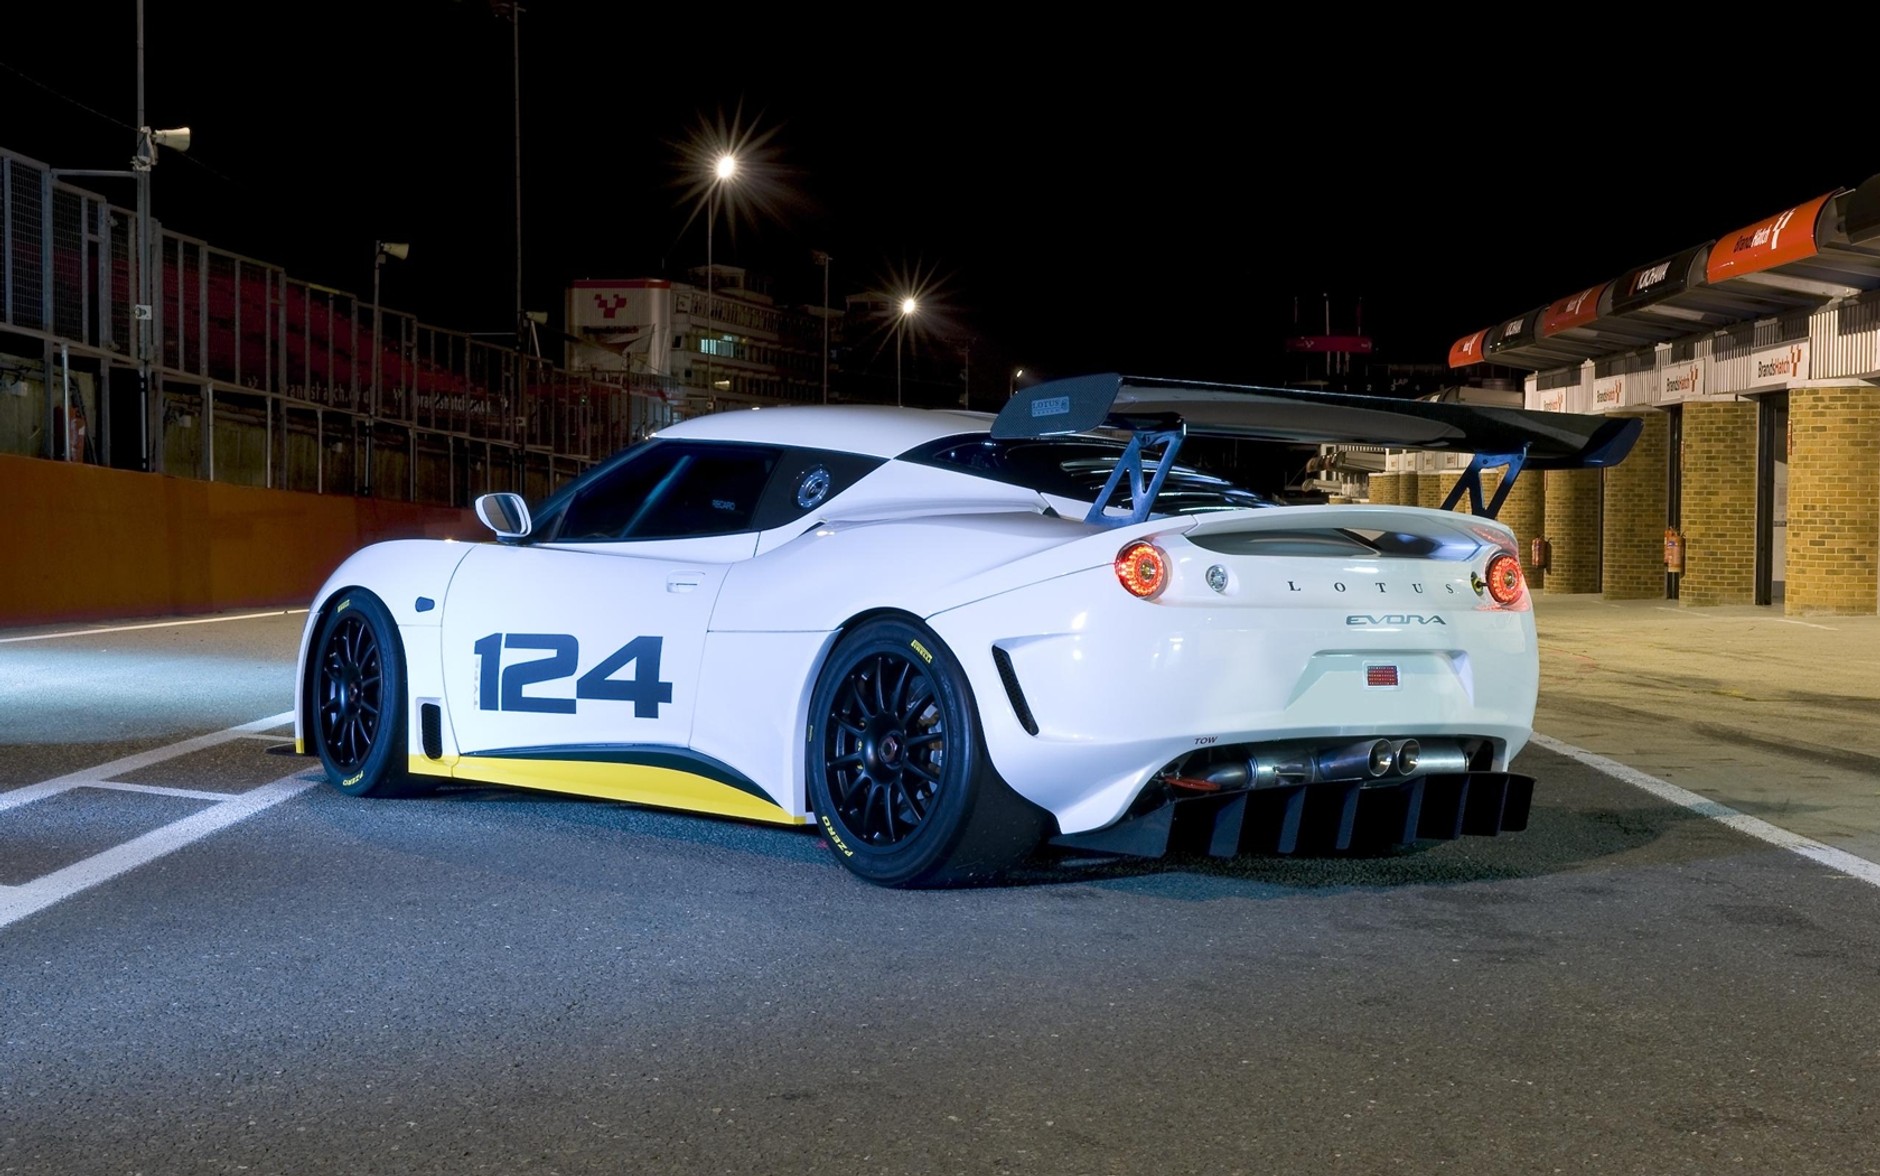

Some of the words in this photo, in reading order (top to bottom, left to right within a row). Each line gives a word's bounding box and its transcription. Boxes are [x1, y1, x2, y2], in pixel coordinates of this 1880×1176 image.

[1758, 356, 1790, 378] BrandsHatch
[1032, 399, 1060, 409] LOTUS
[1288, 581, 1454, 594] LOTUS
[1346, 614, 1447, 625] EVORA
[474, 632, 673, 719] 124
[1194, 736, 1219, 745] TOW
